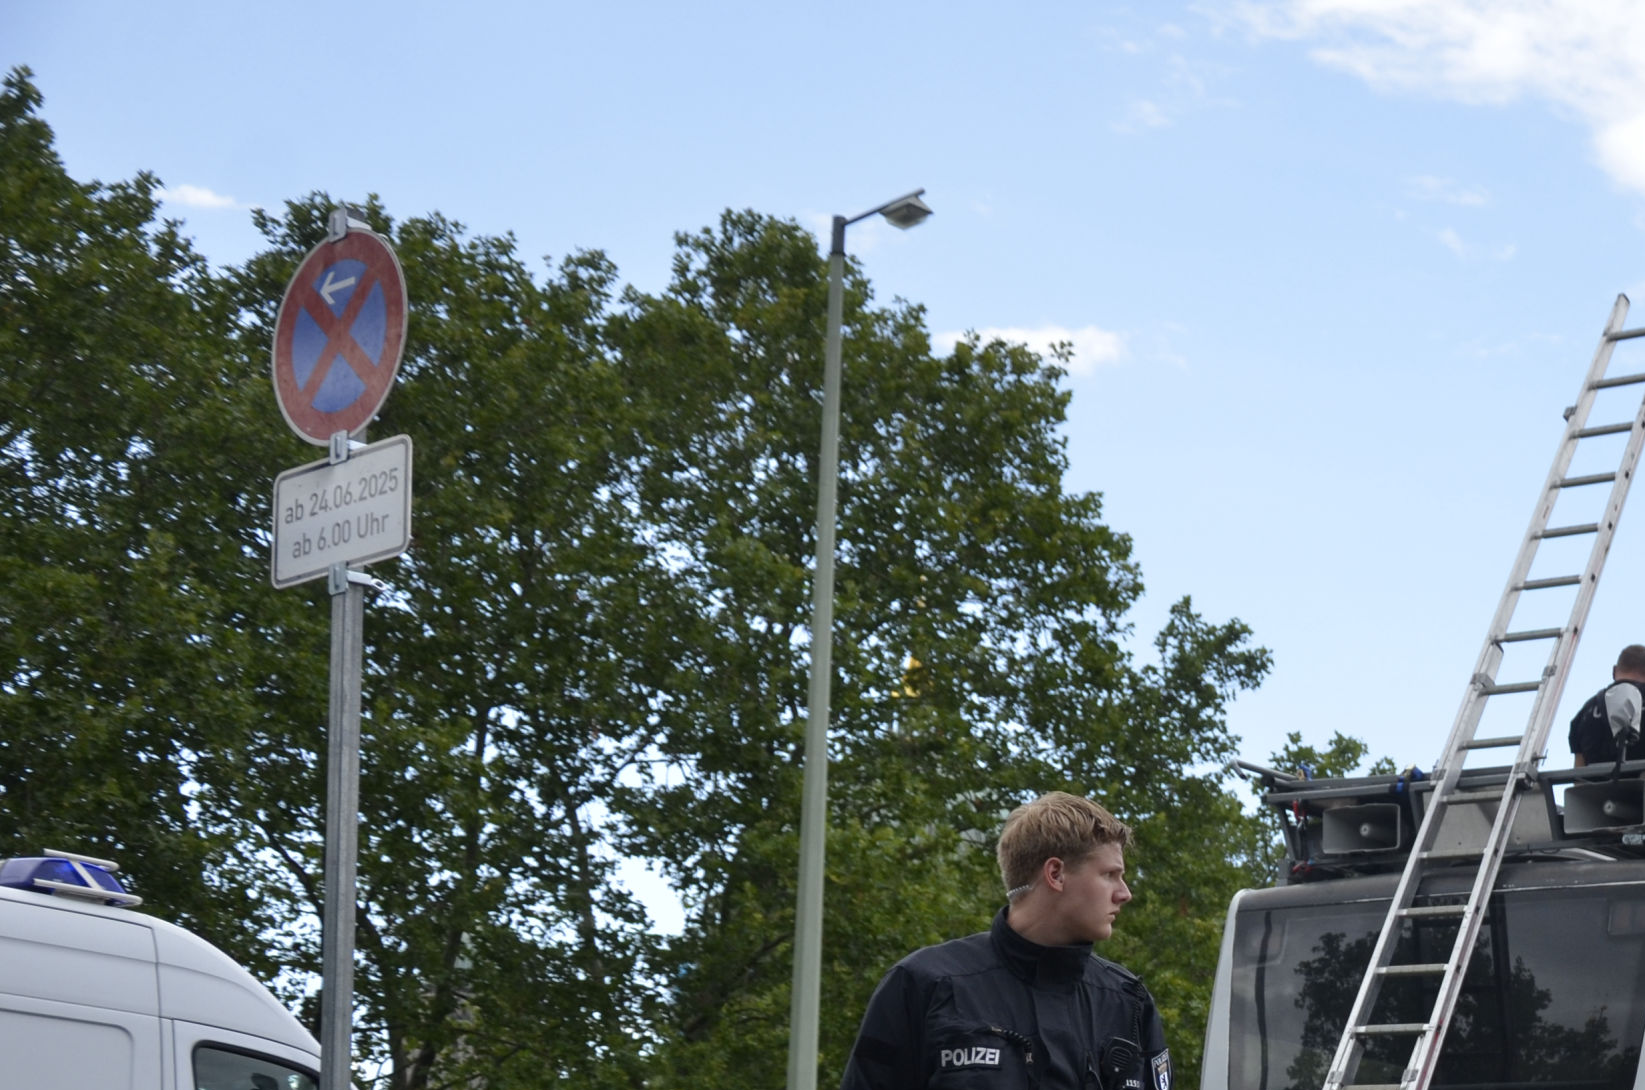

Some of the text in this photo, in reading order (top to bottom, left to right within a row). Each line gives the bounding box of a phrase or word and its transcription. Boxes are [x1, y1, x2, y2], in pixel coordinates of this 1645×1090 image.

[284, 467, 398, 524] ab 24.06.2025
[292, 512, 389, 559] ab 6.00 Uhr
[941, 1046, 1000, 1068] POLIZEI
